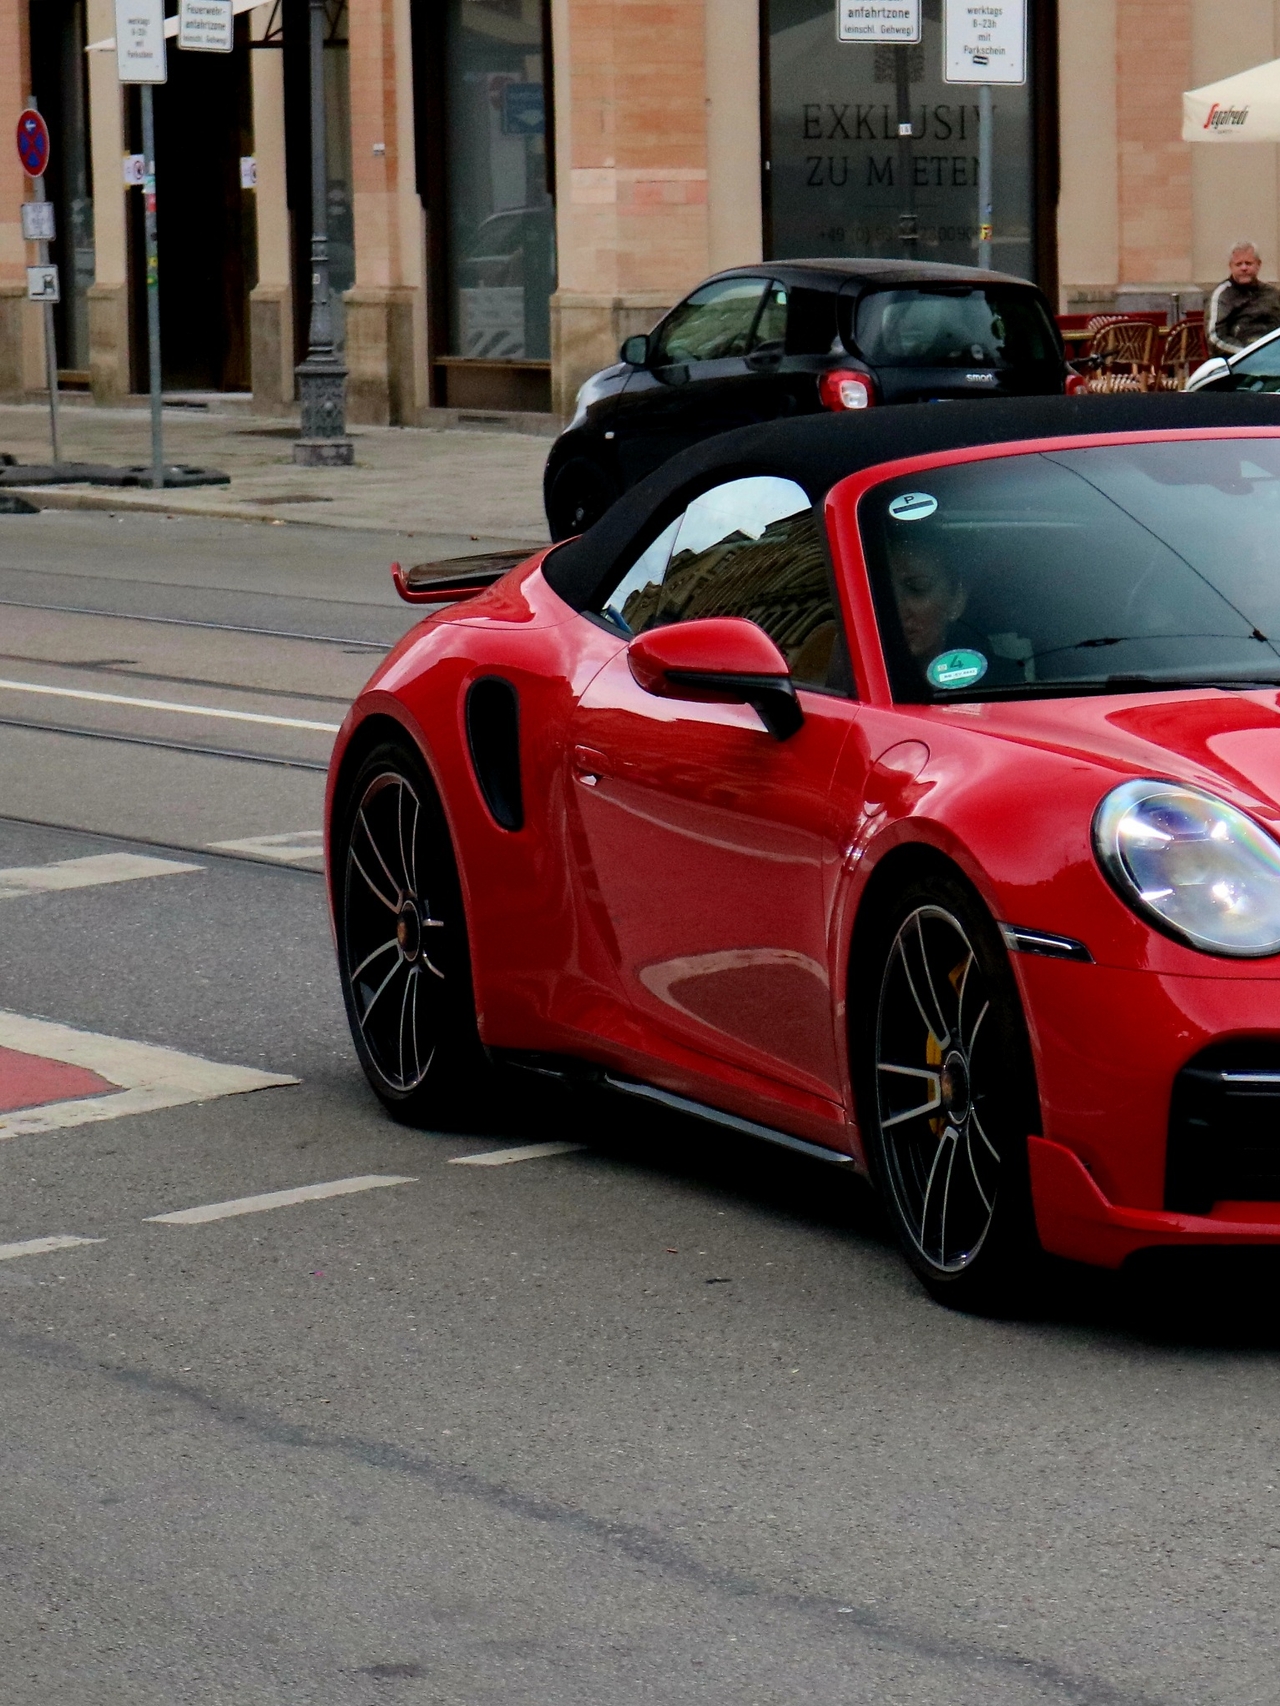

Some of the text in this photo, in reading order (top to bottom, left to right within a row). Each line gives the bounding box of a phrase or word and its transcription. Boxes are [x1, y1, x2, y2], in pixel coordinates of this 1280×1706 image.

[848, 6, 911, 19] anfahrtzone
[967, 7, 1004, 16] werktags
[881, 25, 914, 37] Gehweg)
[978, 32, 991, 41] mit
[964, 45, 1006, 55] Parkschein
[1203, 102, 1251, 129] Segafredo
[806, 155, 981, 186] ZU METE
[965, 373, 994, 382] smart
[903, 495, 914, 504] P
[950, 654, 965, 669] 4
